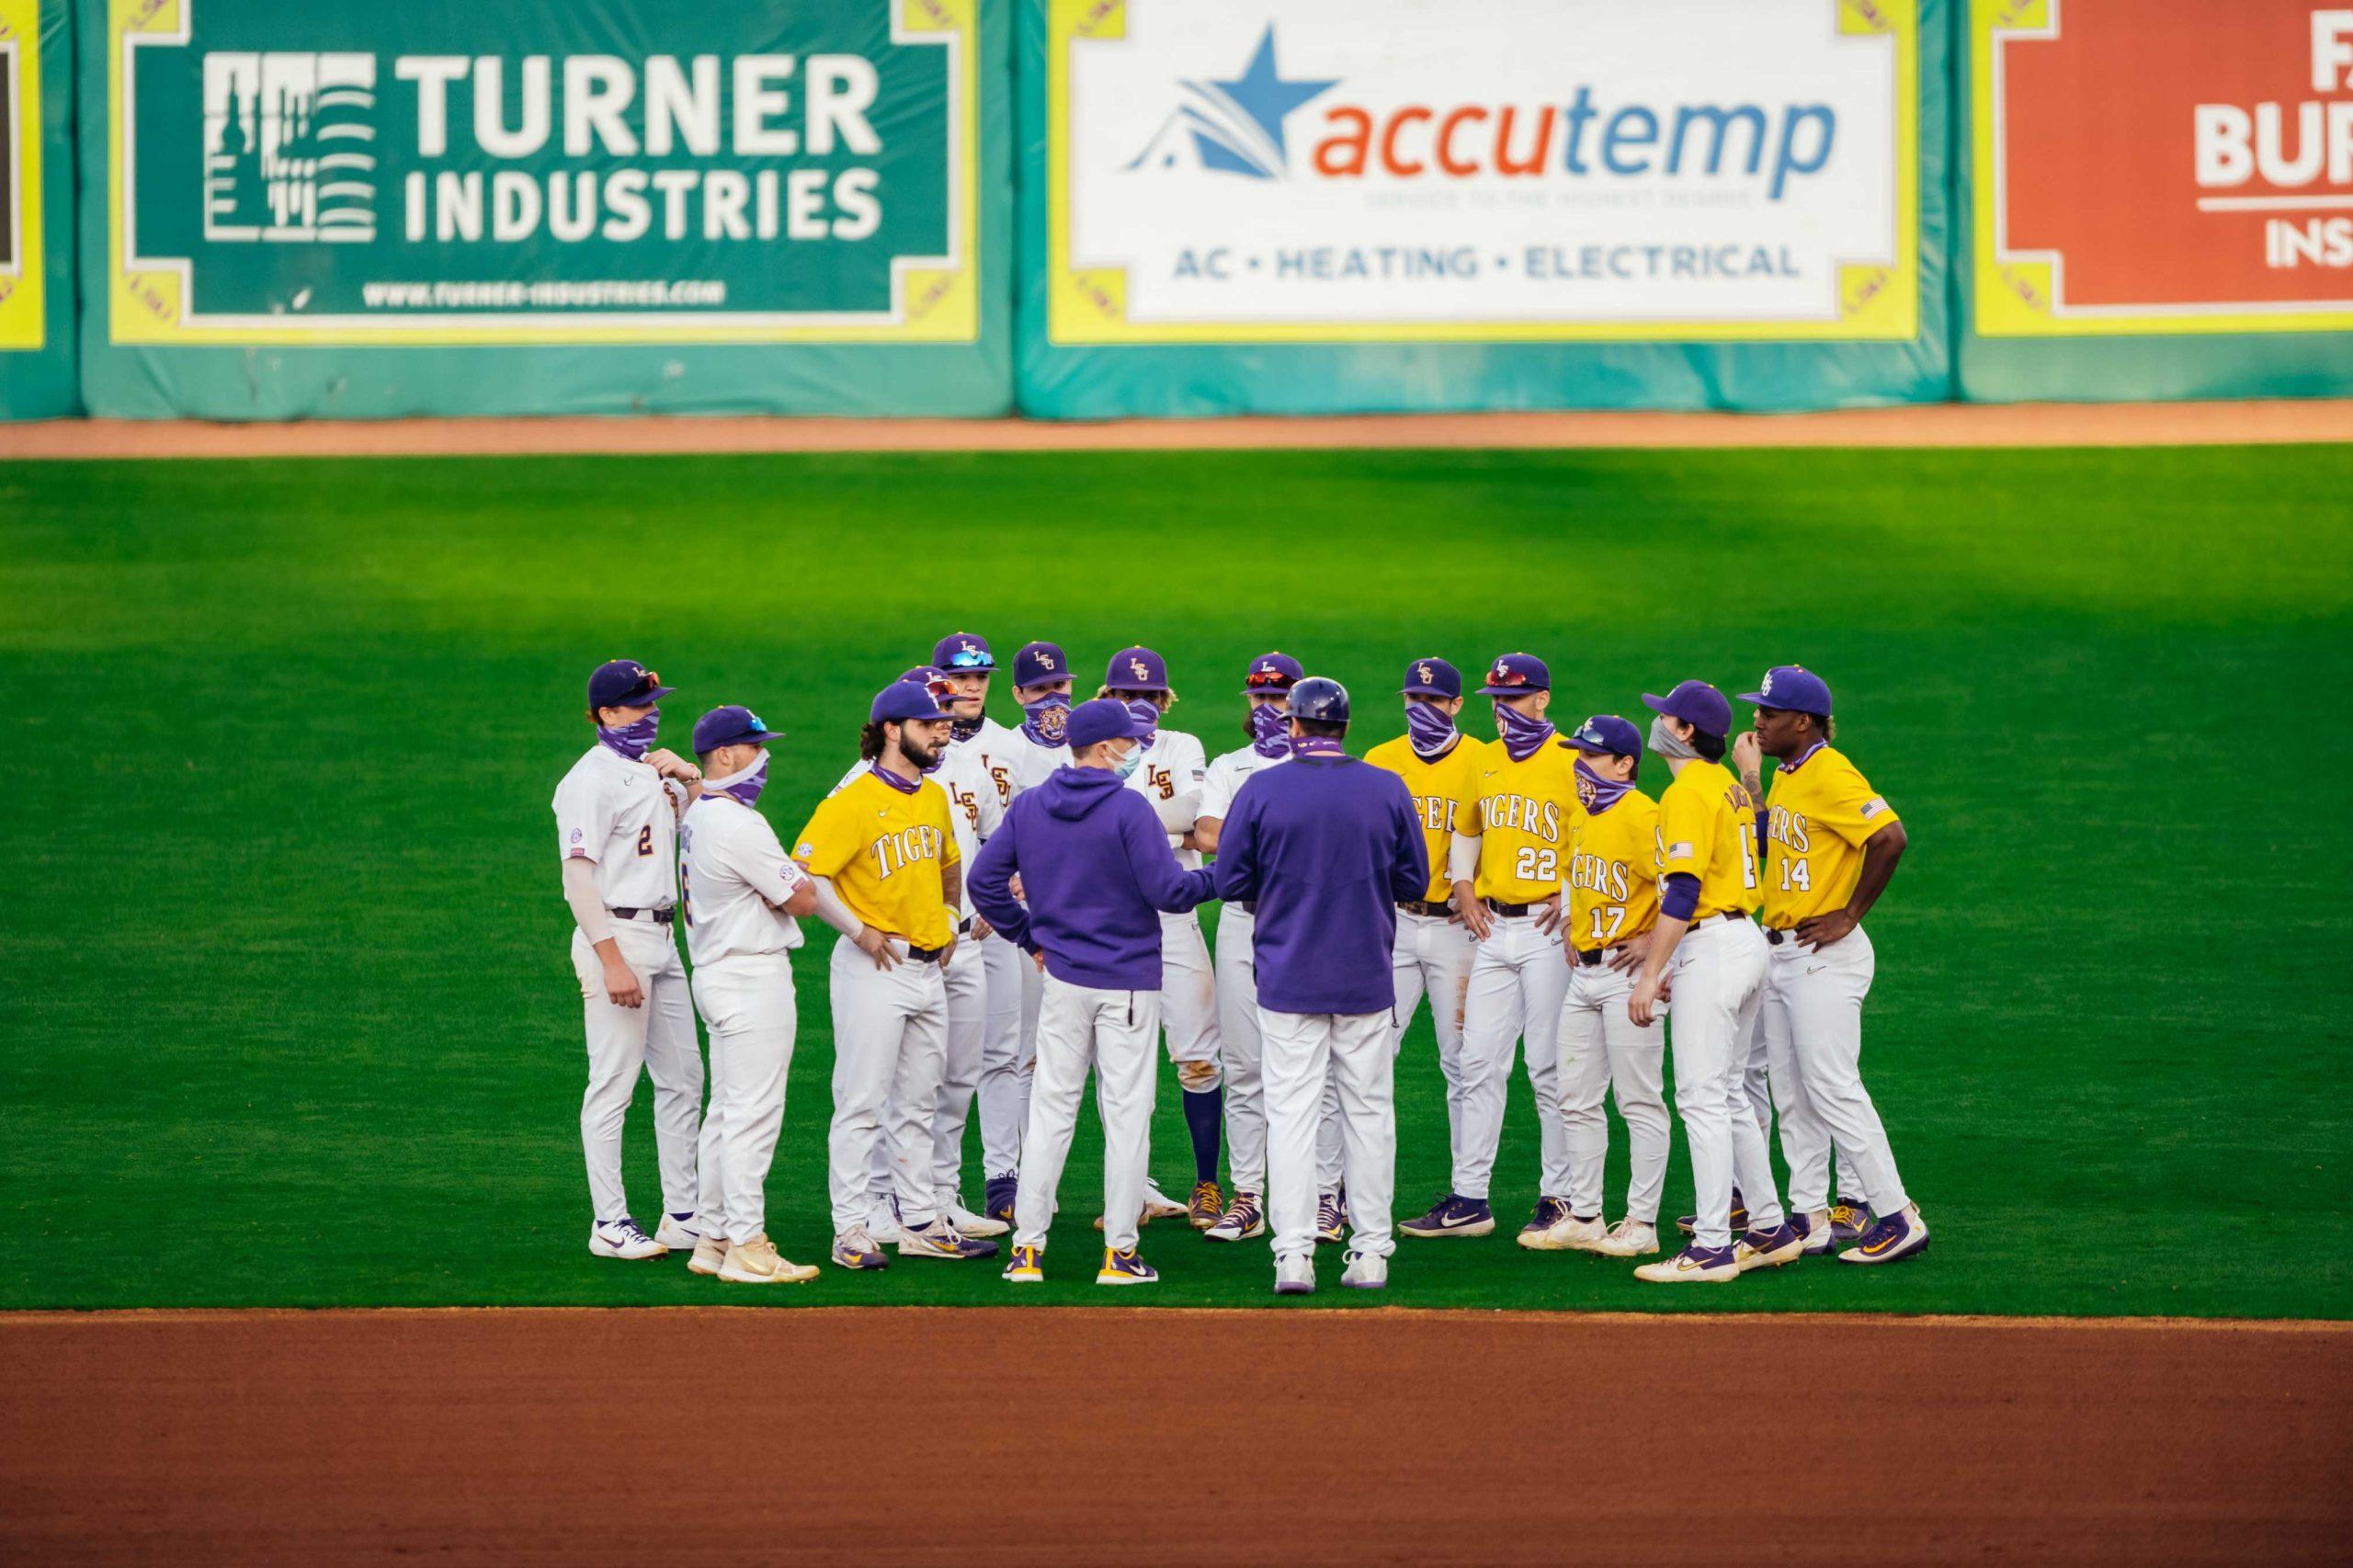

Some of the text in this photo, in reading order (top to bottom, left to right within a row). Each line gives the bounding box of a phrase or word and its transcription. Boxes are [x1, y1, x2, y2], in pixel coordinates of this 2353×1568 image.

[394, 55, 882, 156] TURNER
[1309, 86, 1836, 200] accutemp
[405, 168, 882, 242] INDUSTRIES
[1175, 245, 1800, 279] AC HEATING ELECTRICAL
[1033, 651, 1055, 670] LSU
[1130, 657, 1149, 681] LSU
[1417, 662, 1434, 685] LSU
[638, 824, 654, 858] 2
[1516, 846, 1557, 881] 22
[1781, 857, 1811, 892] 14
[1590, 905, 1626, 938] 17
